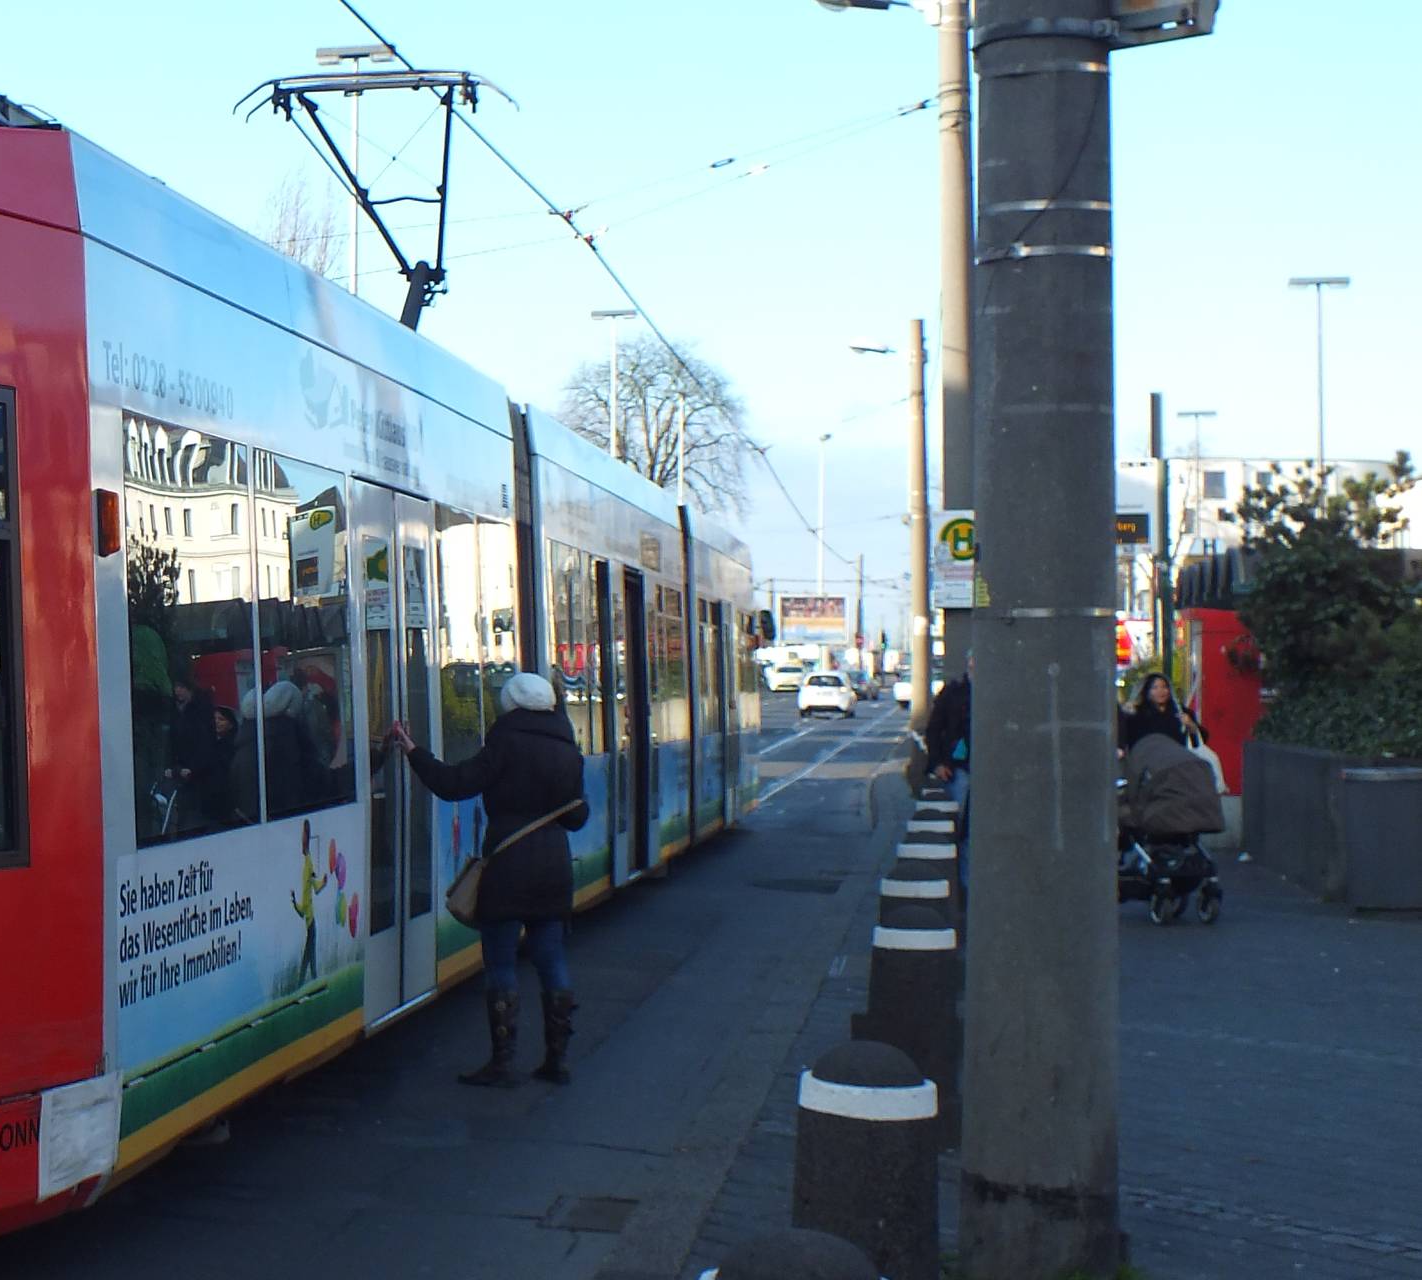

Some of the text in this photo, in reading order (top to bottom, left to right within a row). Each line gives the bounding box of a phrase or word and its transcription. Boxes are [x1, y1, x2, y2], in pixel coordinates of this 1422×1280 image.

[119, 860, 214, 918] Sie haben Zeit für
[119, 891, 254, 963] das Wesentliche im Leben,
[119, 969, 138, 1009] wir
[141, 964, 157, 1000] für
[159, 957, 180, 993] Ihre
